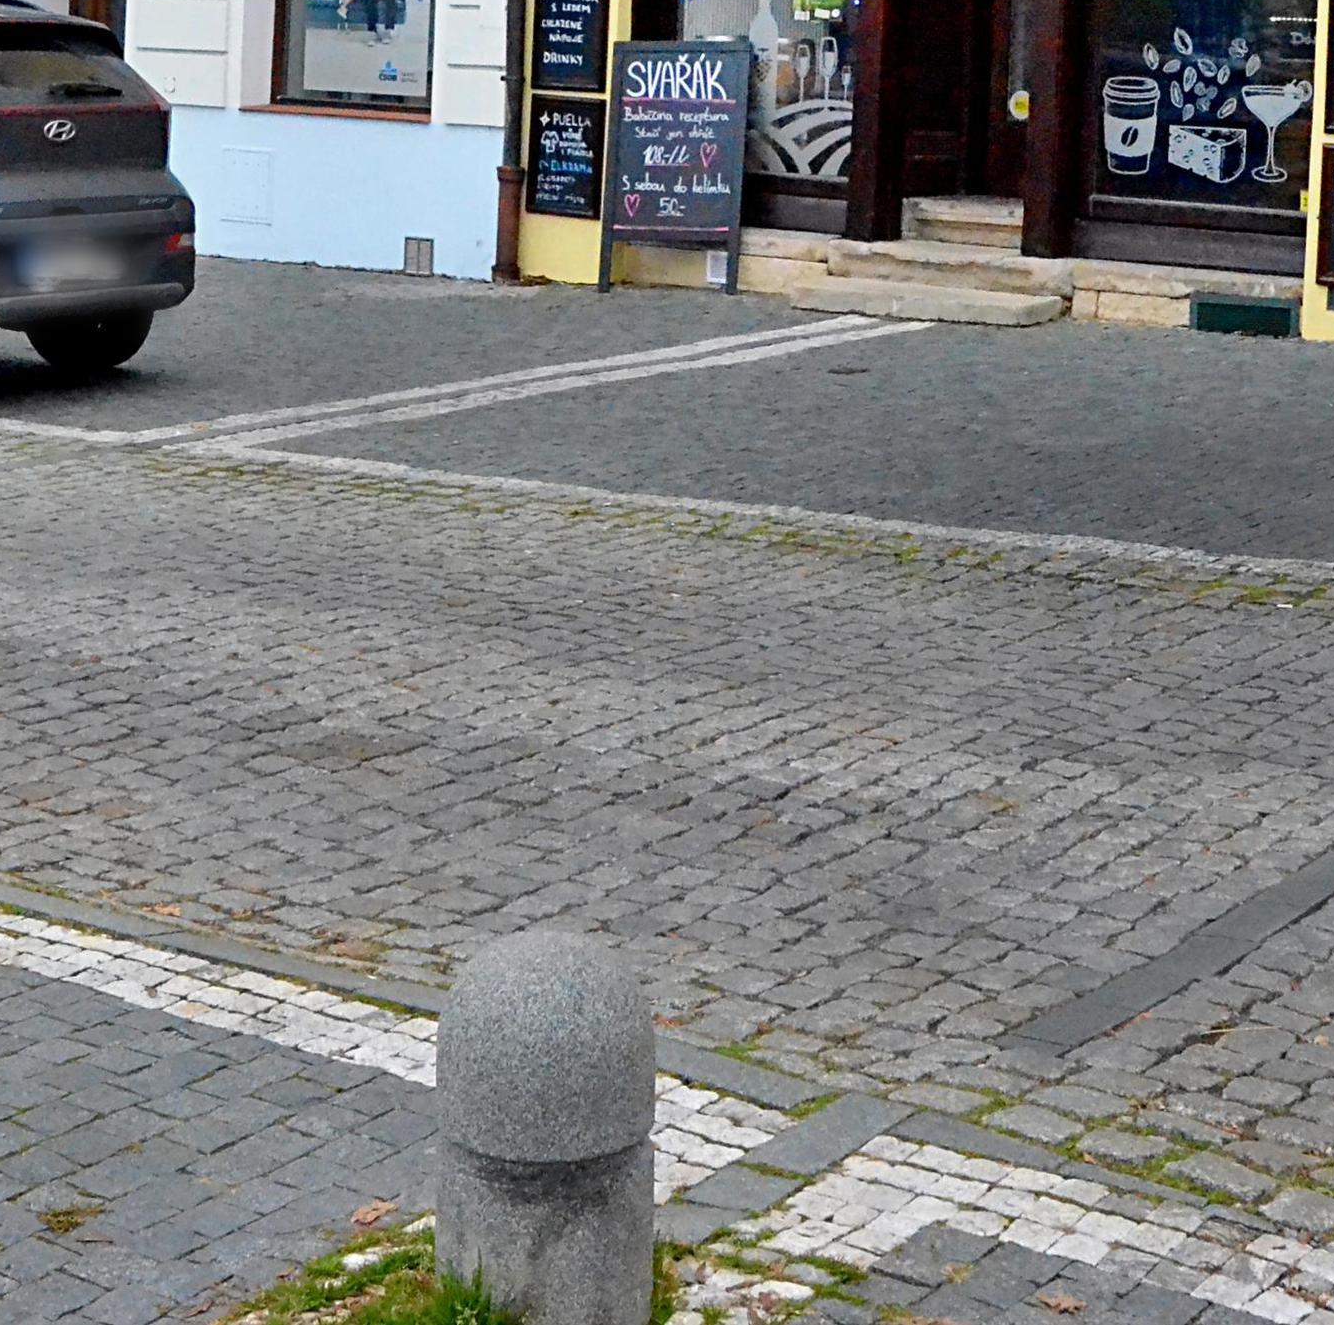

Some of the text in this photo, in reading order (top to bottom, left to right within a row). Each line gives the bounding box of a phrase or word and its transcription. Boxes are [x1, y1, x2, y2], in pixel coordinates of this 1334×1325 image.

[562, 2, 591, 14] LEDEM
[543, 51, 583, 66] DRINKY
[626, 53, 727, 100] SVAŘÁK
[553, 112, 592, 128] PUELLA
[679, 107, 730, 125] receptura
[667, 131, 684, 141] jen
[622, 174, 631, 191] S
[634, 171, 665, 193] sebou
[673, 176, 688, 193] do
